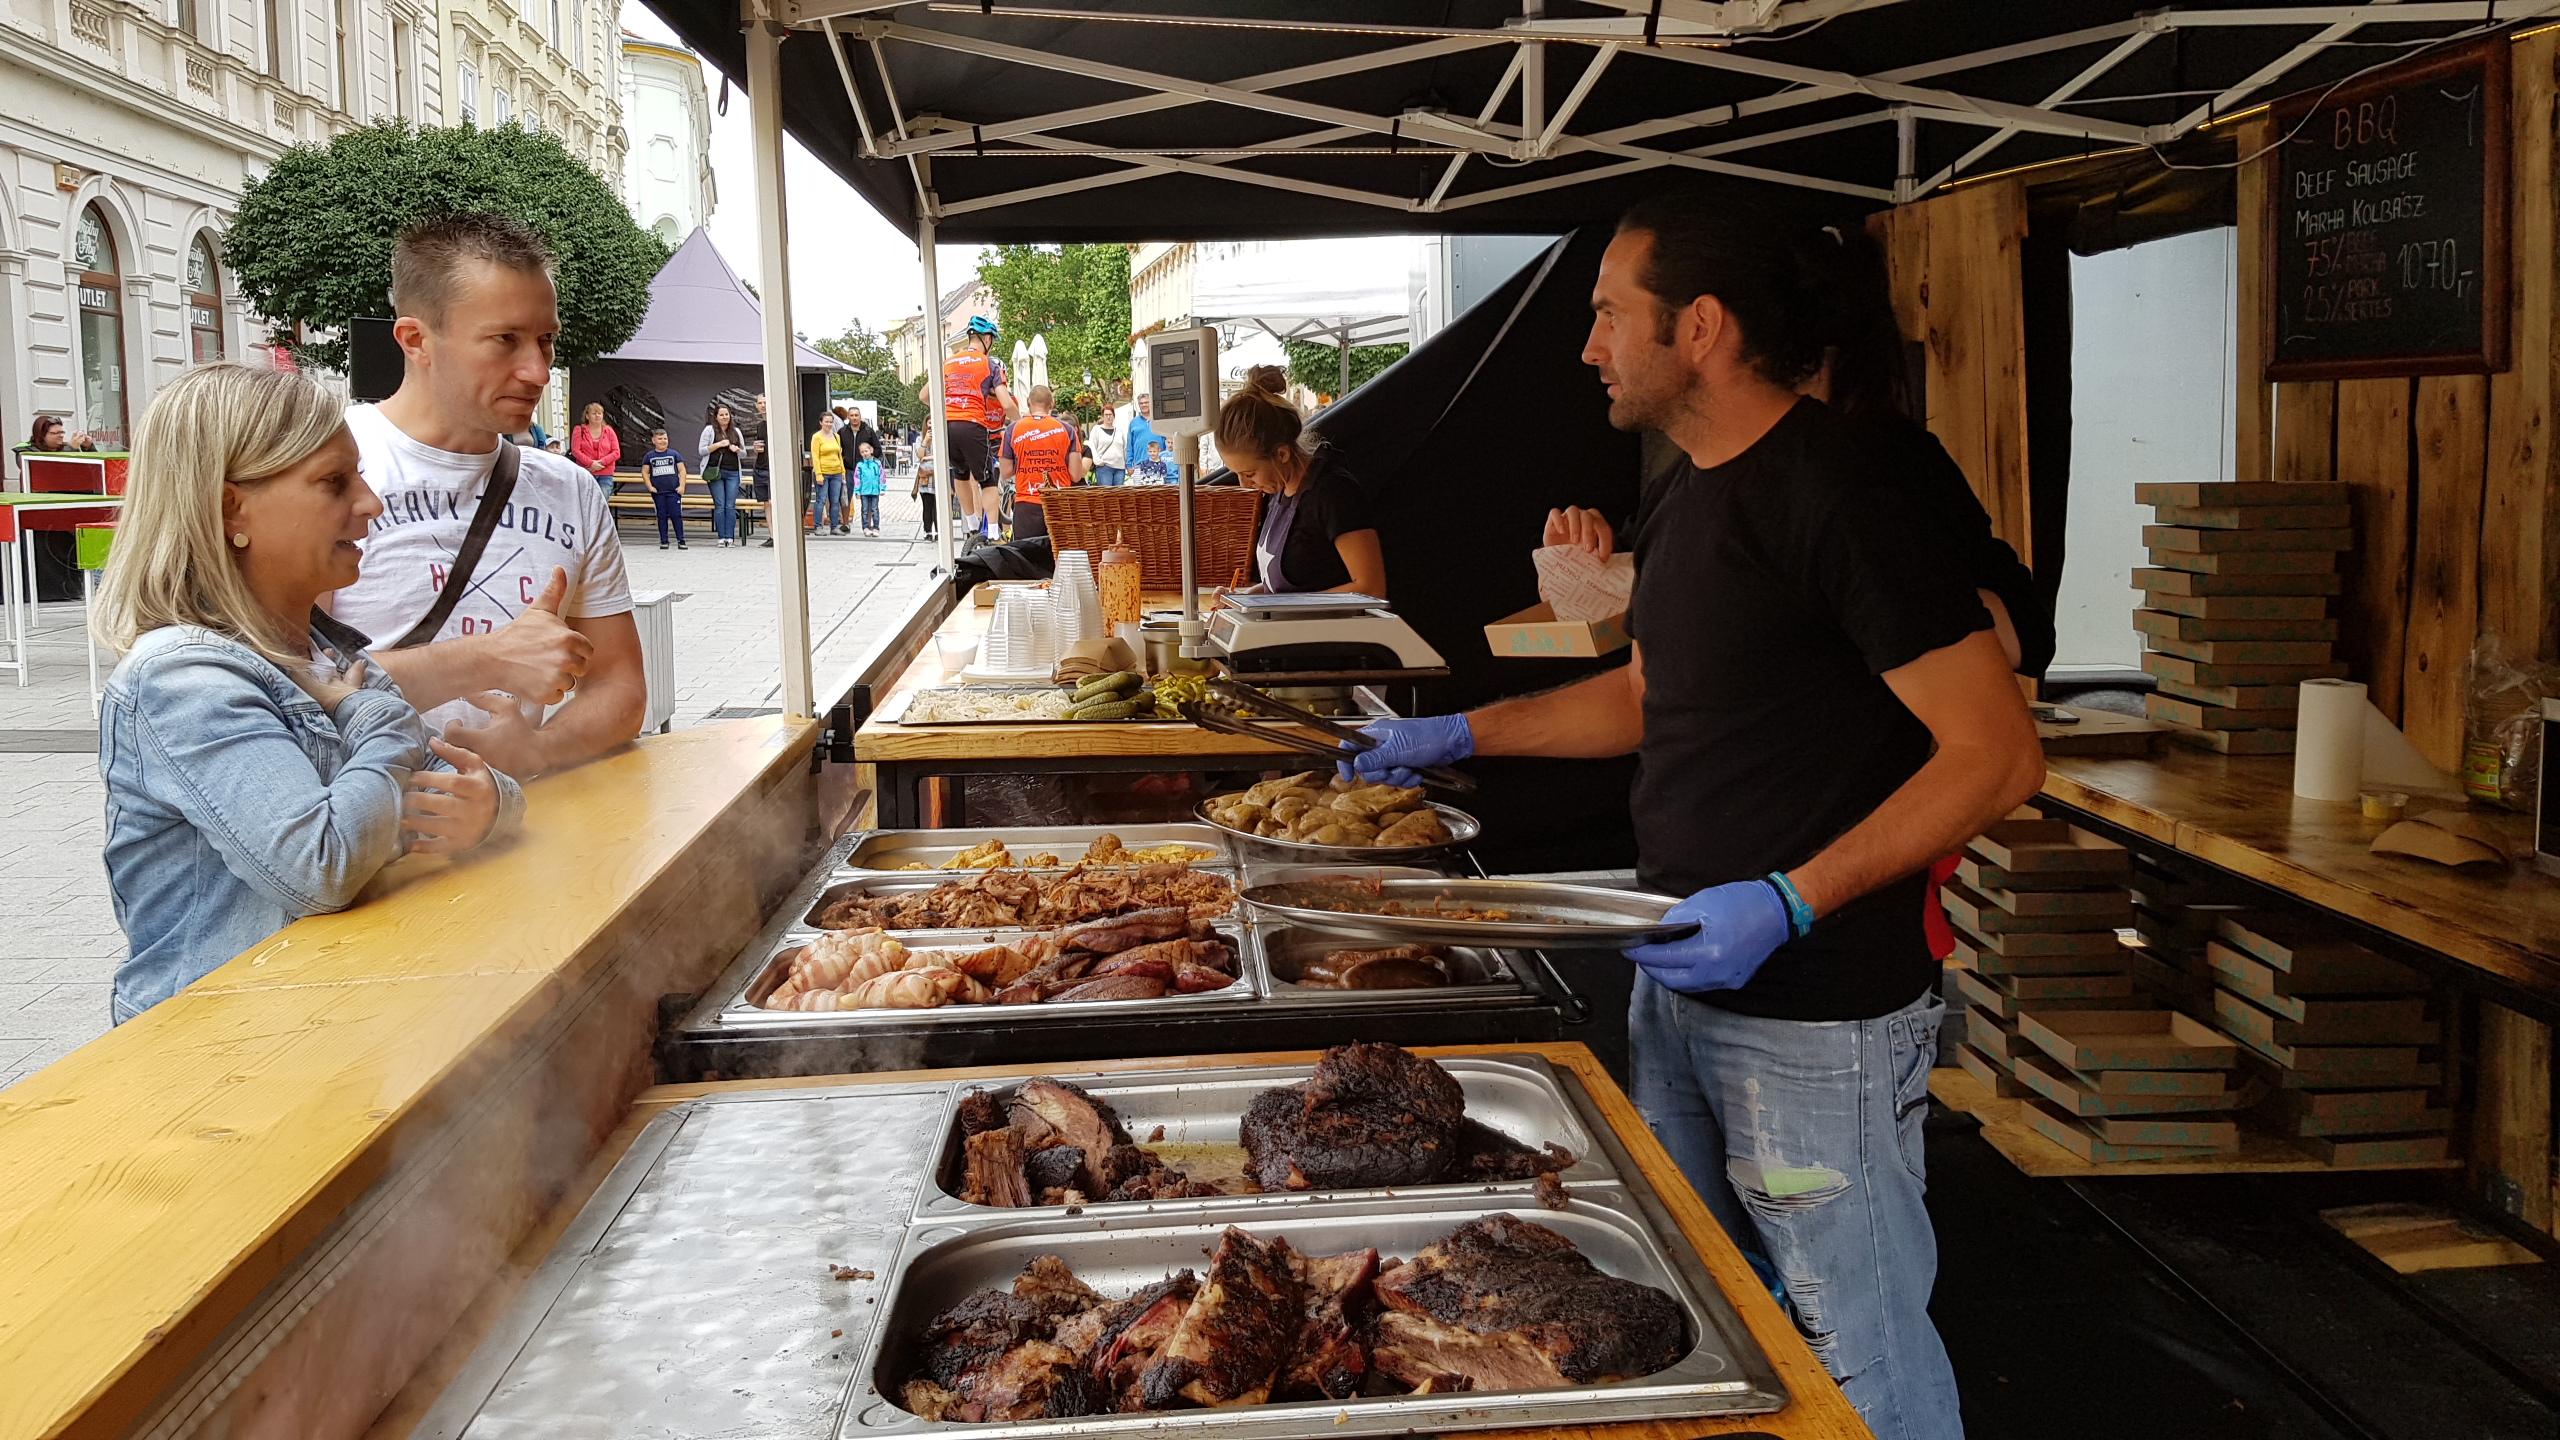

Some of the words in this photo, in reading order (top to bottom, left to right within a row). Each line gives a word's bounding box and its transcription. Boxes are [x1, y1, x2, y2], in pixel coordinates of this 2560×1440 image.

[2334, 95, 2398, 150] BBQ
[2295, 169, 2336, 200] BEEF
[2345, 151, 2418, 188] SAUSAGE
[2295, 208, 2344, 238] MARHA
[79, 287, 107, 308] UTLET
[475, 495, 575, 550] OOLS
[430, 564, 447, 592] H
[519, 575, 534, 604] C
